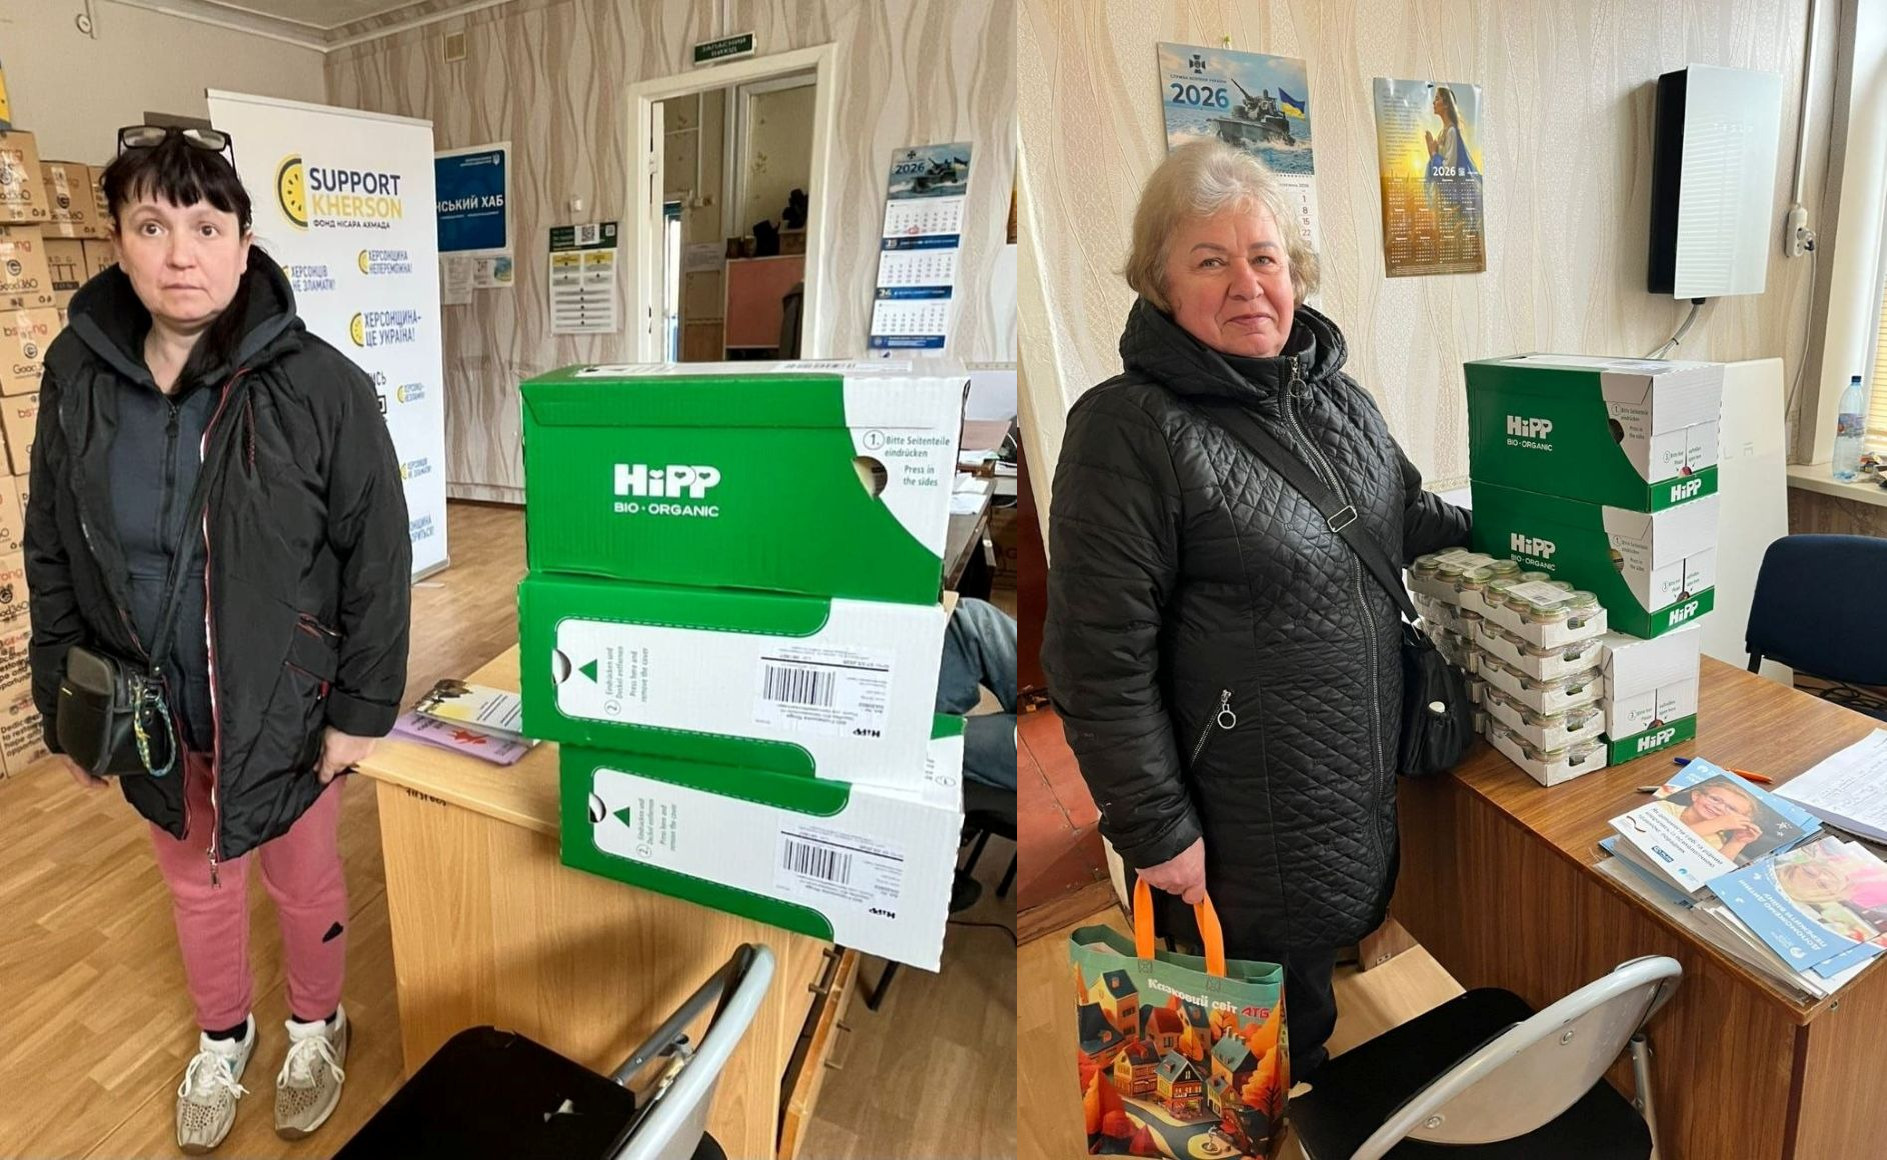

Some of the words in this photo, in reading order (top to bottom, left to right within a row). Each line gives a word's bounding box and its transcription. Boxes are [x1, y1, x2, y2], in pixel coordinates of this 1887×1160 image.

[1170, 83, 1229, 108] 2026
[895, 162, 925, 174] 2026
[1433, 166, 1456, 176] 2026
[309, 167, 401, 196] SUPPORT
[312, 194, 402, 219] KHERSON
[482, 194, 503, 208] ХАБ
[314, 220, 336, 228] ФОНД
[337, 220, 361, 229] НІСАРА
[363, 221, 390, 229] АХМАДА
[366, 331, 378, 347] ЦЕ
[380, 326, 416, 345] УКРАЇНА!
[1507, 414, 1553, 439] HiPP
[886, 436, 905, 445] Bitte
[907, 436, 950, 446] Seitenteile
[1507, 438, 1518, 446] BIO
[1522, 440, 1552, 451] ORGANIC
[904, 465, 925, 474] Press
[927, 465, 935, 474] in
[614, 463, 721, 499] HiPP
[903, 477, 916, 486] the
[918, 478, 938, 487] sides
[1671, 479, 1702, 502] HiPP
[614, 502, 639, 513] BIO
[648, 503, 720, 518] ORGANIC
[1510, 532, 1556, 560] HiPP
[1669, 600, 1699, 626] HiPP
[1637, 727, 1676, 753] HiPP
[1148, 978, 1208, 1008] Казковий
[1212, 1000, 1238, 1014] світ
